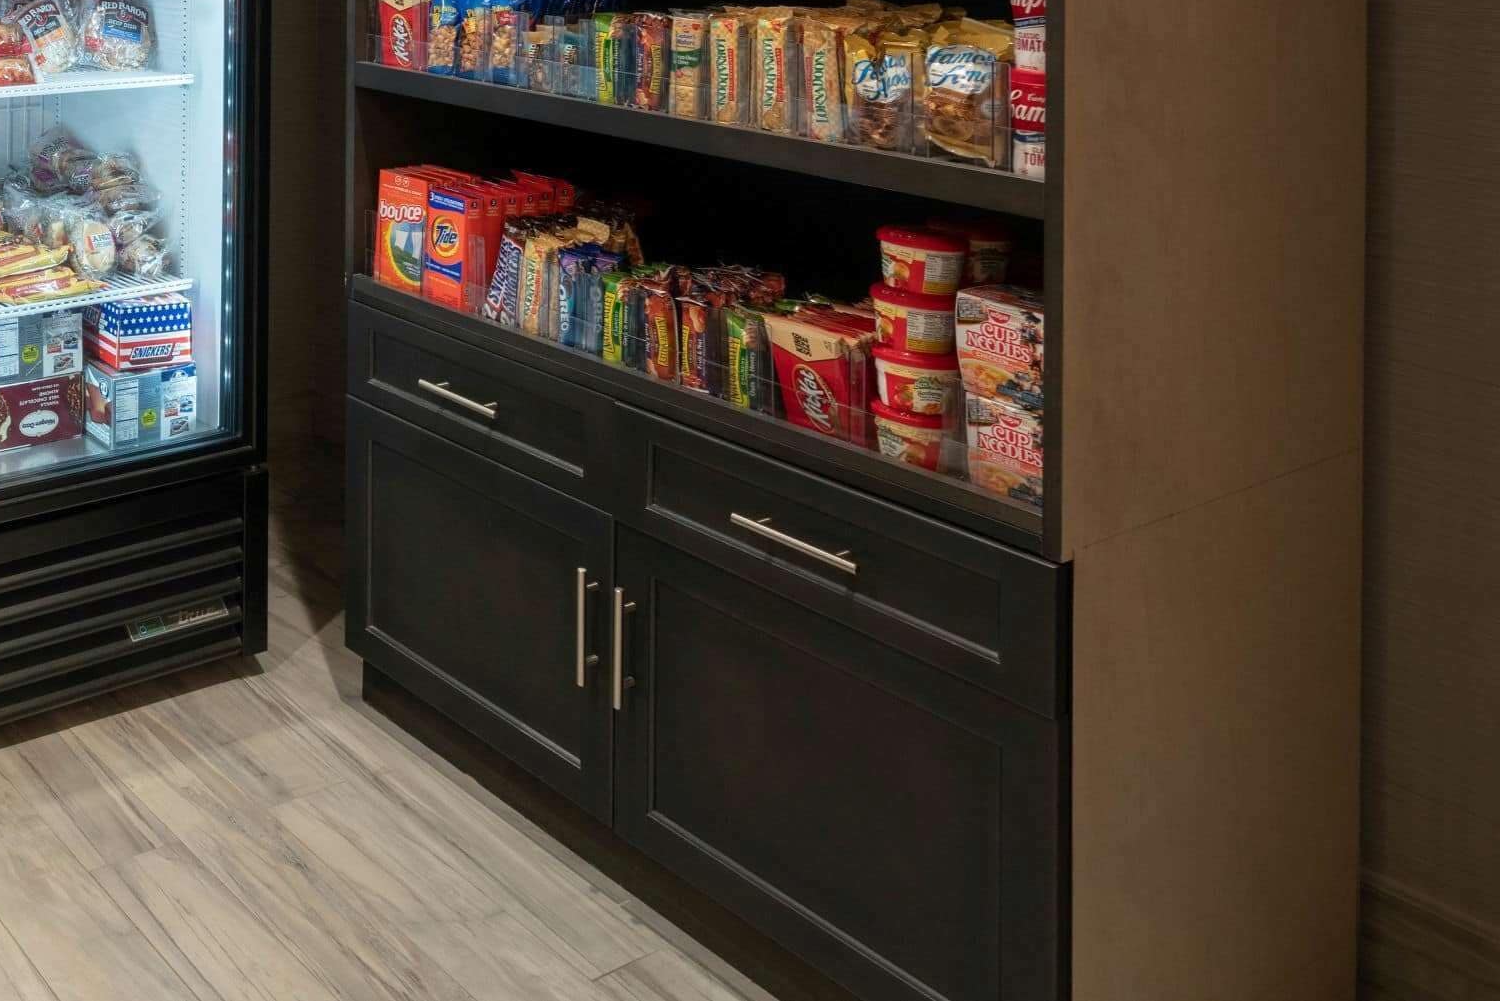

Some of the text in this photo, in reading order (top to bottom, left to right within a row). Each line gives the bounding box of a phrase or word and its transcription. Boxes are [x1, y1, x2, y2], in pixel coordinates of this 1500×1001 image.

[101, 1, 148, 19] RED BARON
[379, 200, 424, 223] bounce
[434, 223, 458, 246] Tide
[980, 322, 1018, 344] CUP
[130, 344, 173, 359] SNICKERS
[966, 330, 1032, 363] NOODLES
[992, 425, 1030, 447] CUP
[978, 432, 1043, 467] NOODLES
